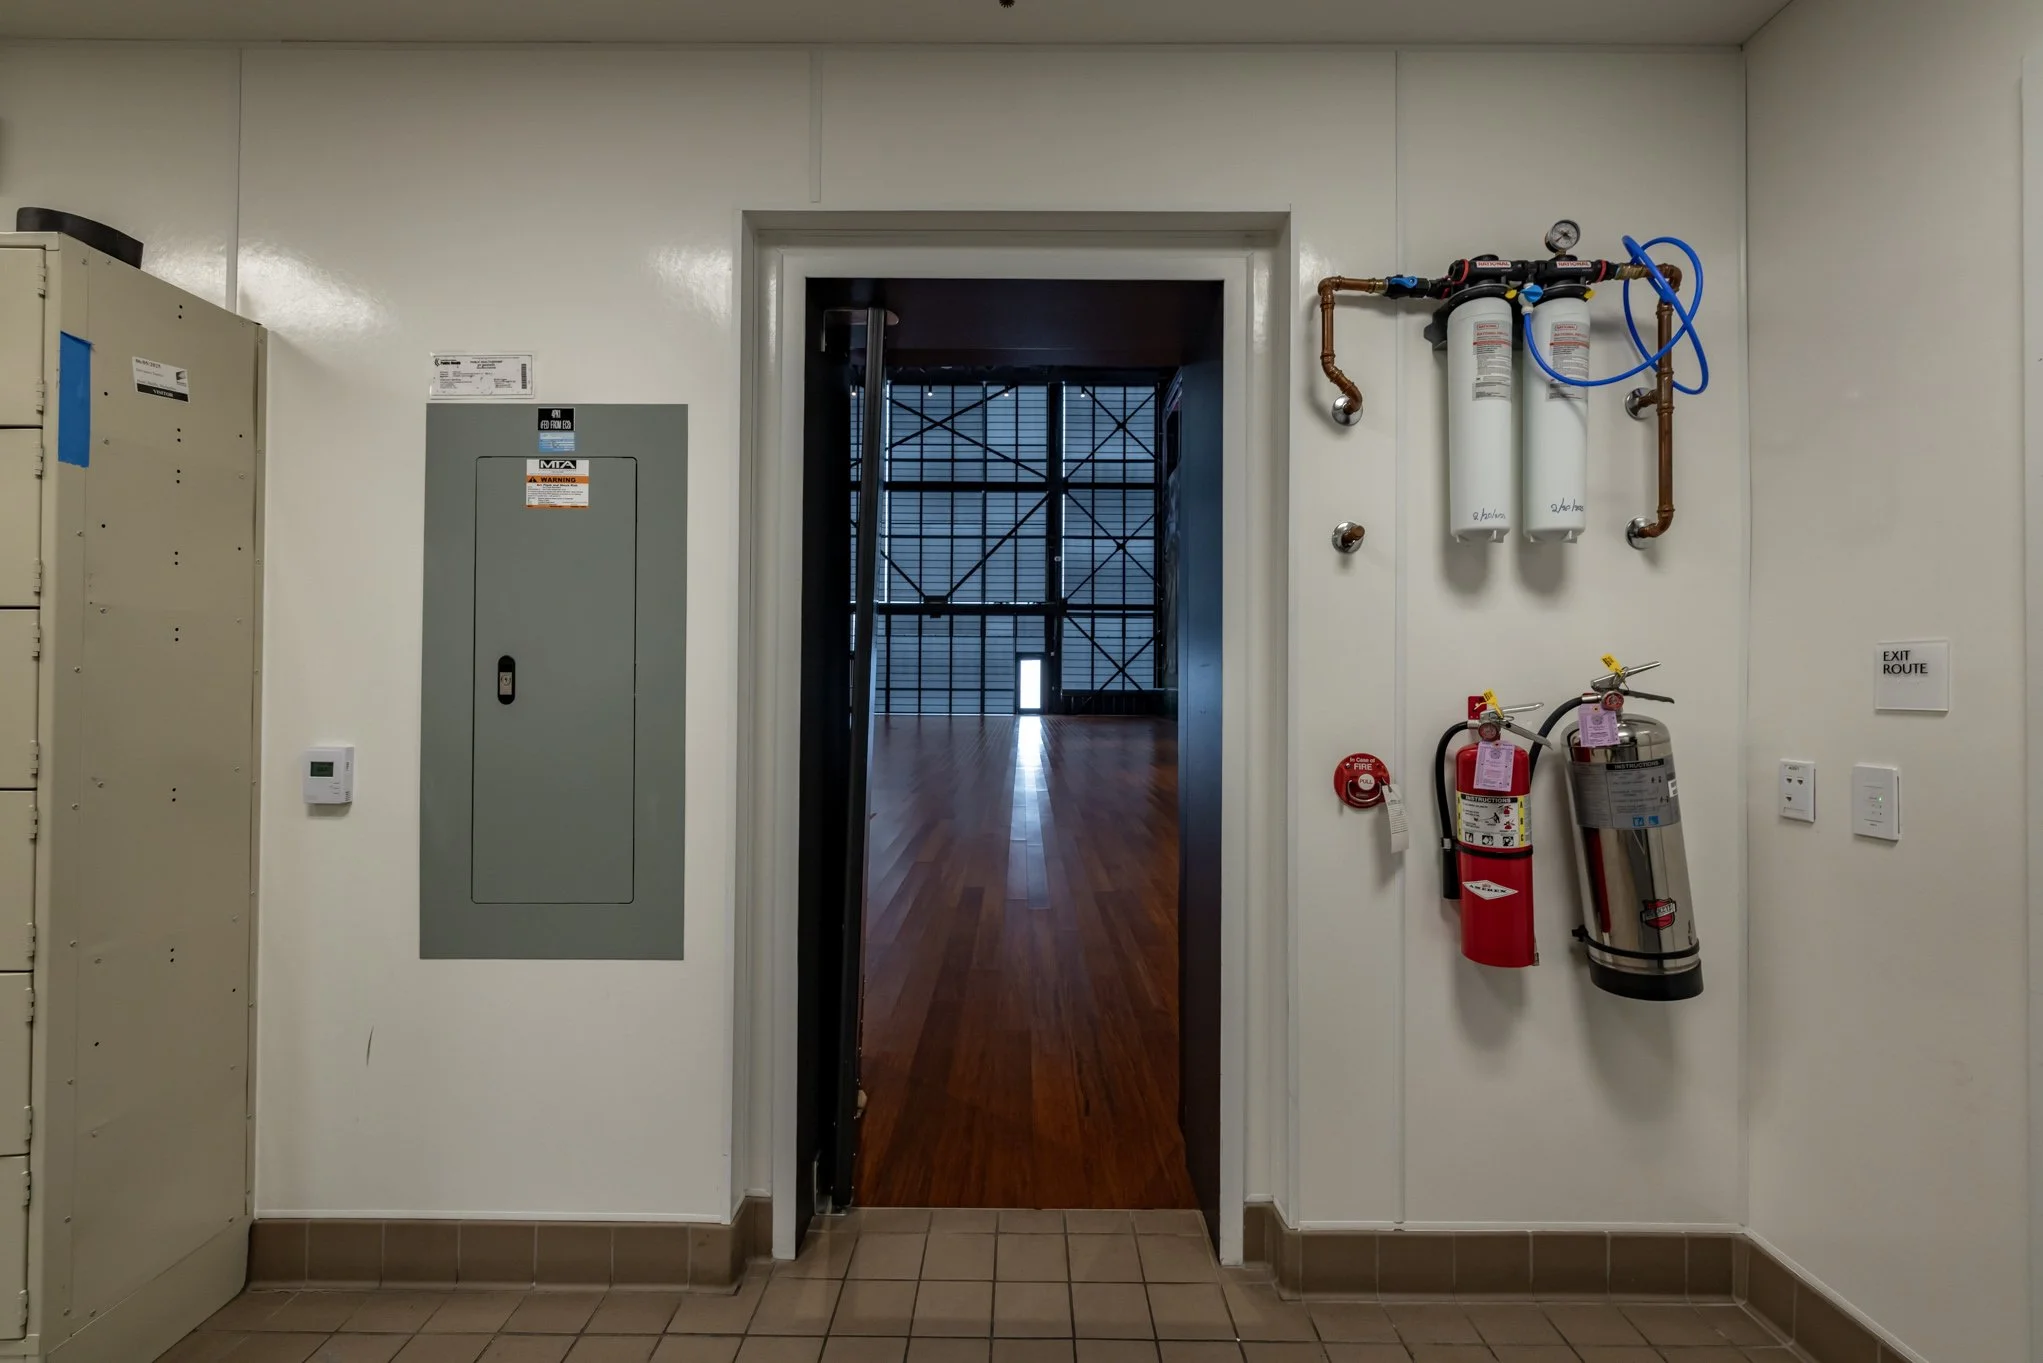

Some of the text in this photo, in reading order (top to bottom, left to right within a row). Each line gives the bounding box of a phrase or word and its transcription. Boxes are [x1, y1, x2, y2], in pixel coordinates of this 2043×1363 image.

[152, 389, 174, 397] VISITOR
[550, 420, 561, 429] FROM
[540, 460, 576, 469] MTA
[1883, 650, 1911, 661] EXIT
[1883, 663, 1928, 675] ROUTE
[1353, 763, 1373, 771] FIRE
[1614, 760, 1659, 769] INSTRUCTIONS
[1465, 795, 1511, 803] INSTRUCTIONS
